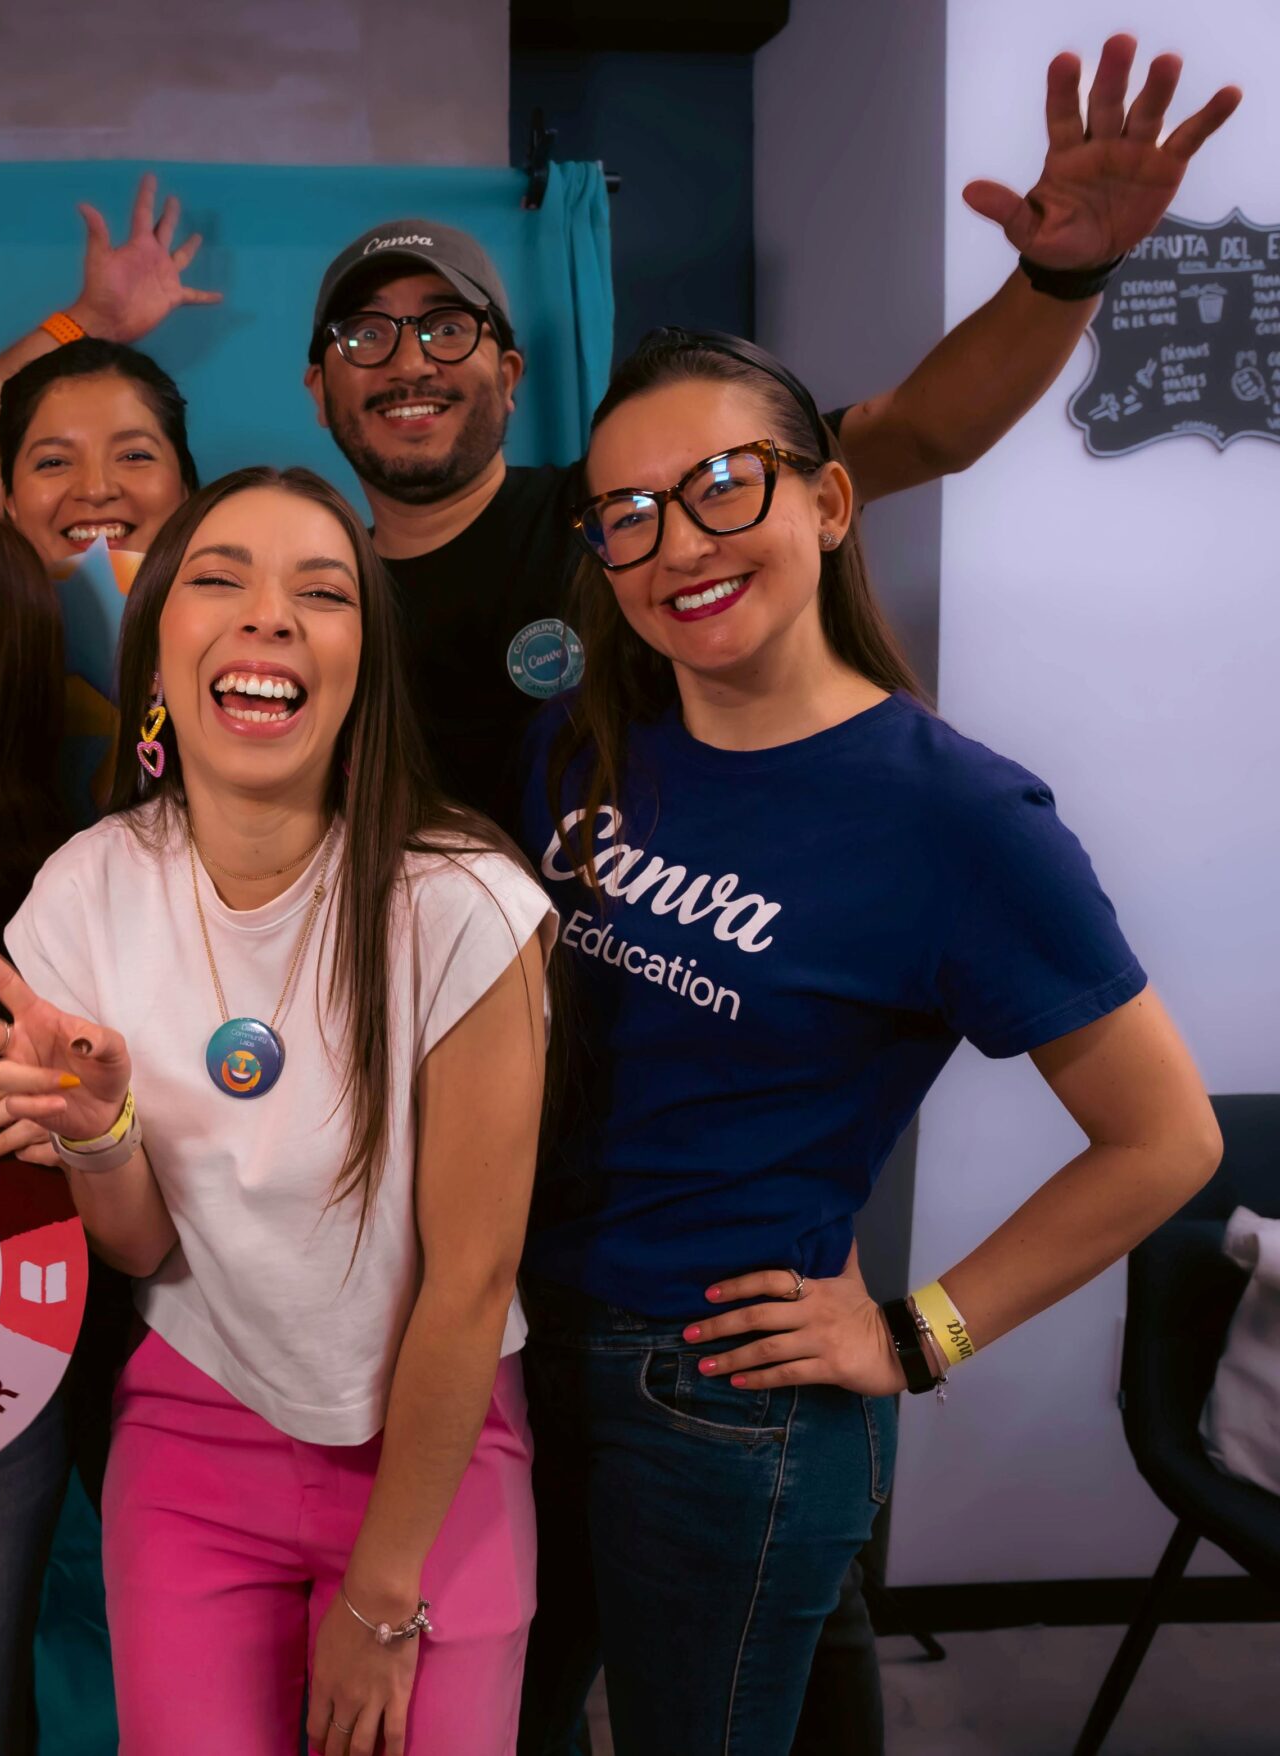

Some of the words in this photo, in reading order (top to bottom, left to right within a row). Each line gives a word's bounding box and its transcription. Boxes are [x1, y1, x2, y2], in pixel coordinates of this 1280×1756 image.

[363, 234, 433, 255] Canva
[1128, 234, 1209, 260] FRUTA
[1221, 236, 1252, 260] DEL
[541, 804, 782, 953] Canva
[561, 909, 741, 1021] Education
[231, 1029, 268, 1045] Community
[946, 1318, 974, 1360] nva
